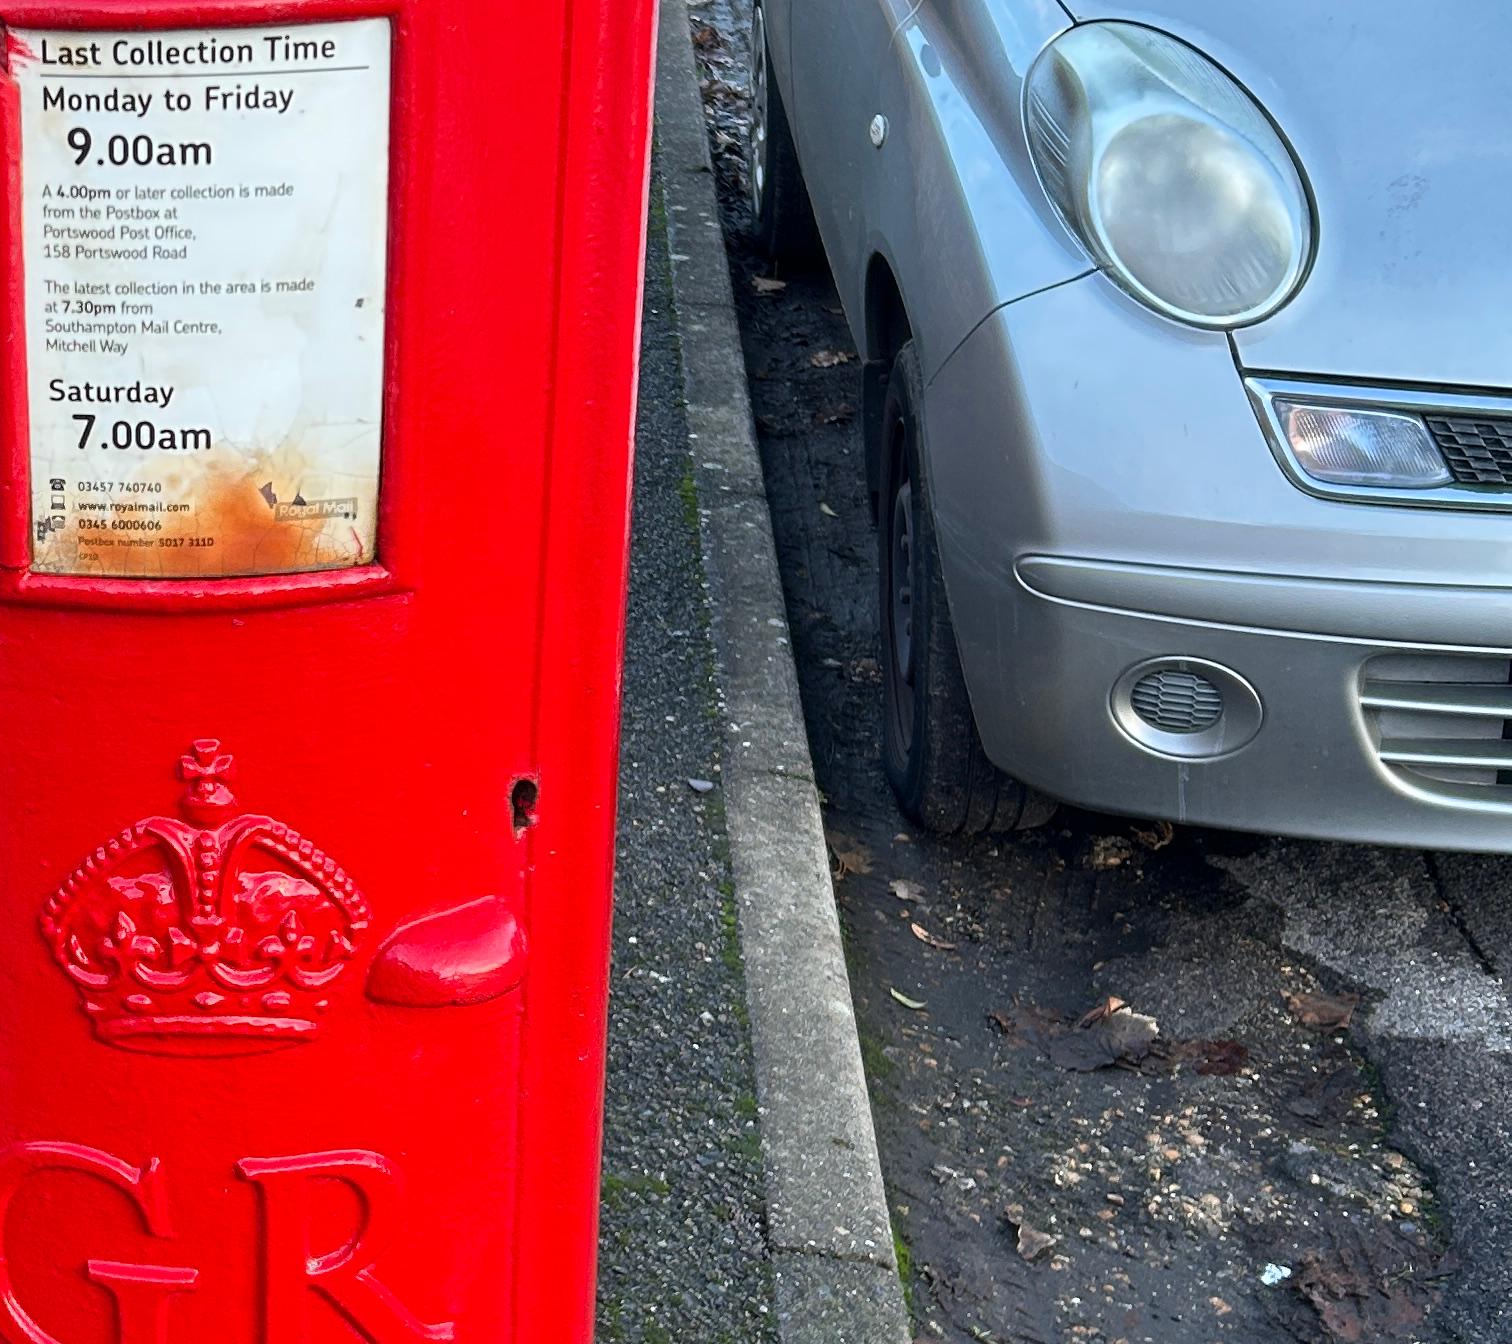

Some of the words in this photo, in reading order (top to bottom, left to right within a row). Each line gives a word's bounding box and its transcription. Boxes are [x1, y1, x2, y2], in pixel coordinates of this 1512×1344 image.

[41, 40, 101, 66] Last
[113, 38, 252, 66] Collection
[263, 36, 335, 62] Time
[43, 86, 152, 118] Monday
[164, 89, 191, 112] to
[205, 84, 294, 114] Friday
[67, 127, 211, 167] 9.00am
[41, 183, 53, 199] A
[57, 185, 111, 202] 4.00pm
[115, 188, 131, 201] or
[134, 185, 167, 201] later
[170, 185, 235, 200] collection
[239, 186, 250, 199] is
[254, 182, 294, 197] made
[42, 203, 75, 219] from
[79, 205, 102, 220] the
[106, 204, 160, 220] Postbox
[163, 207, 178, 220] at
[43, 223, 116, 240] Portswood
[120, 225, 150, 241] Post
[154, 225, 197, 241] Office,
[43, 243, 71, 259] 158
[75, 244, 148, 260] Portswood
[152, 245, 188, 260] Road
[43, 279, 70, 295] The
[74, 281, 111, 296] latest
[114, 281, 178, 296] collection
[182, 281, 195, 295] in
[199, 280, 222, 295] the
[225, 282, 256, 295] area
[260, 282, 272, 293] is
[275, 277, 315, 292] made
[44, 300, 58, 314] at
[62, 300, 115, 316] 7.30pm
[120, 300, 154, 315] from
[46, 319, 136, 337] Southampton
[141, 319, 169, 335] Mail
[173, 319, 222, 335] Centre,
[45, 338, 97, 353] Mitchell
[100, 340, 128, 356] Way
[49, 379, 174, 409] Saturday
[72, 414, 211, 450] 7.00am
[77, 480, 114, 493] 03457
[118, 481, 162, 494] 740740
[77, 498, 190, 514] www.royalmail.com
[279, 502, 320, 518] Royal
[322, 500, 354, 514] Mail
[78, 518, 107, 530] 0345
[111, 519, 162, 531] 6000606
